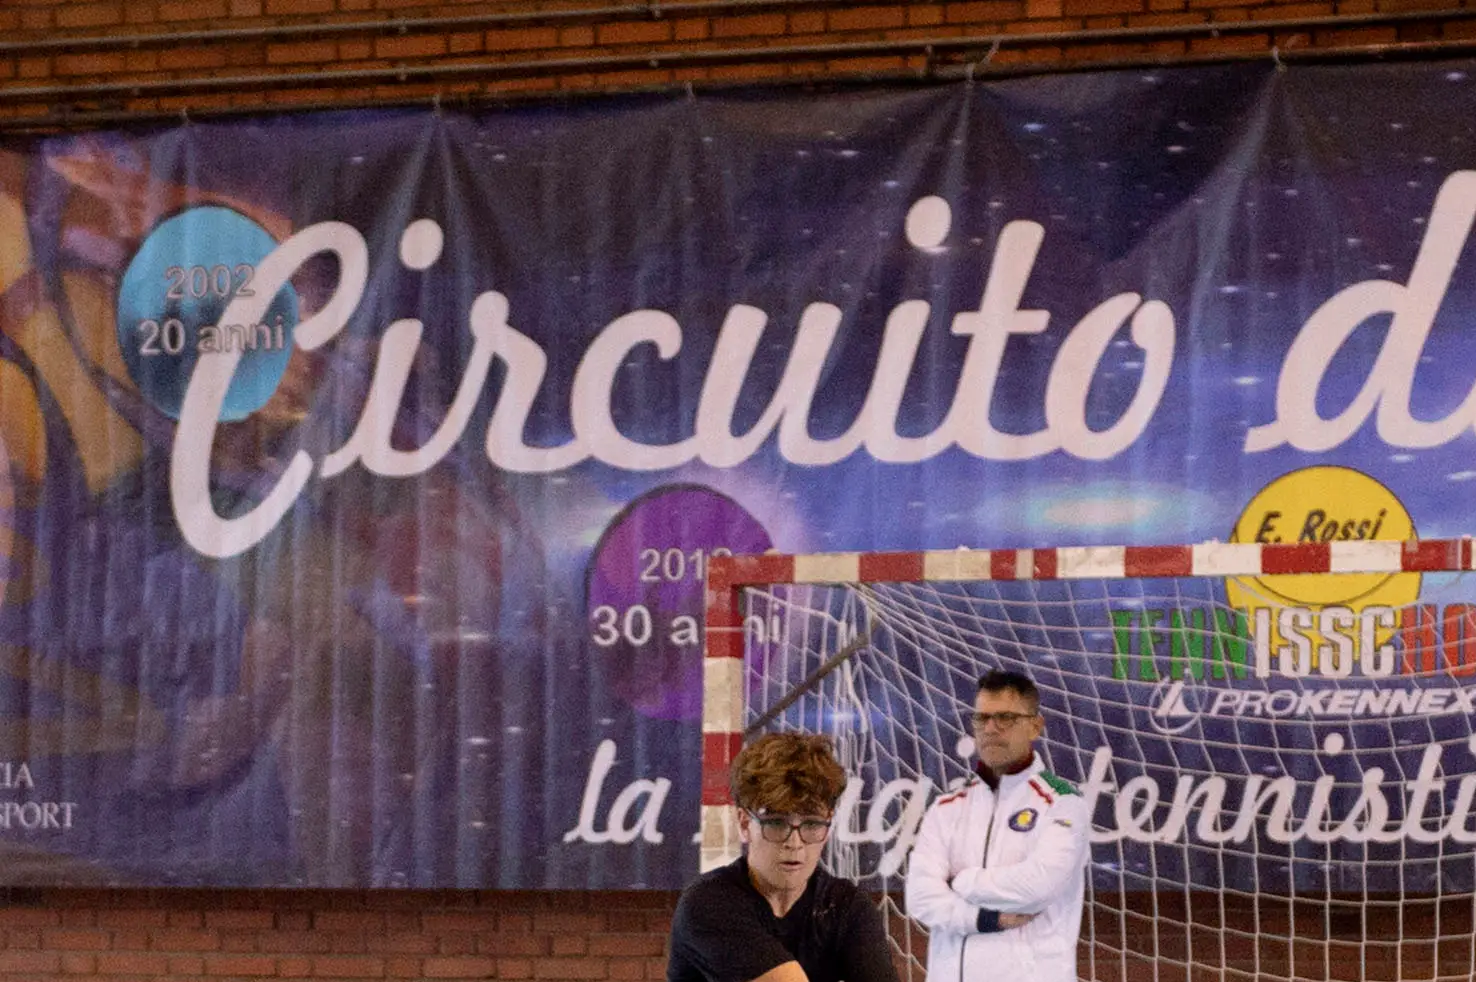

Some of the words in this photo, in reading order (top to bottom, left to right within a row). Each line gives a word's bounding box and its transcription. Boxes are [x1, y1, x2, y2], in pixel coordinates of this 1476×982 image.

[165, 263, 257, 299] 2002
[137, 318, 186, 356] 20
[198, 315, 285, 354] anni
[171, 196, 1176, 558] Circuito
[1254, 511, 1283, 543] E.
[1299, 508, 1388, 542] Rossi
[640, 547, 733, 582] 201
[592, 604, 653, 647] 30
[670, 602, 781, 645] ani
[564, 739, 672, 843] la
